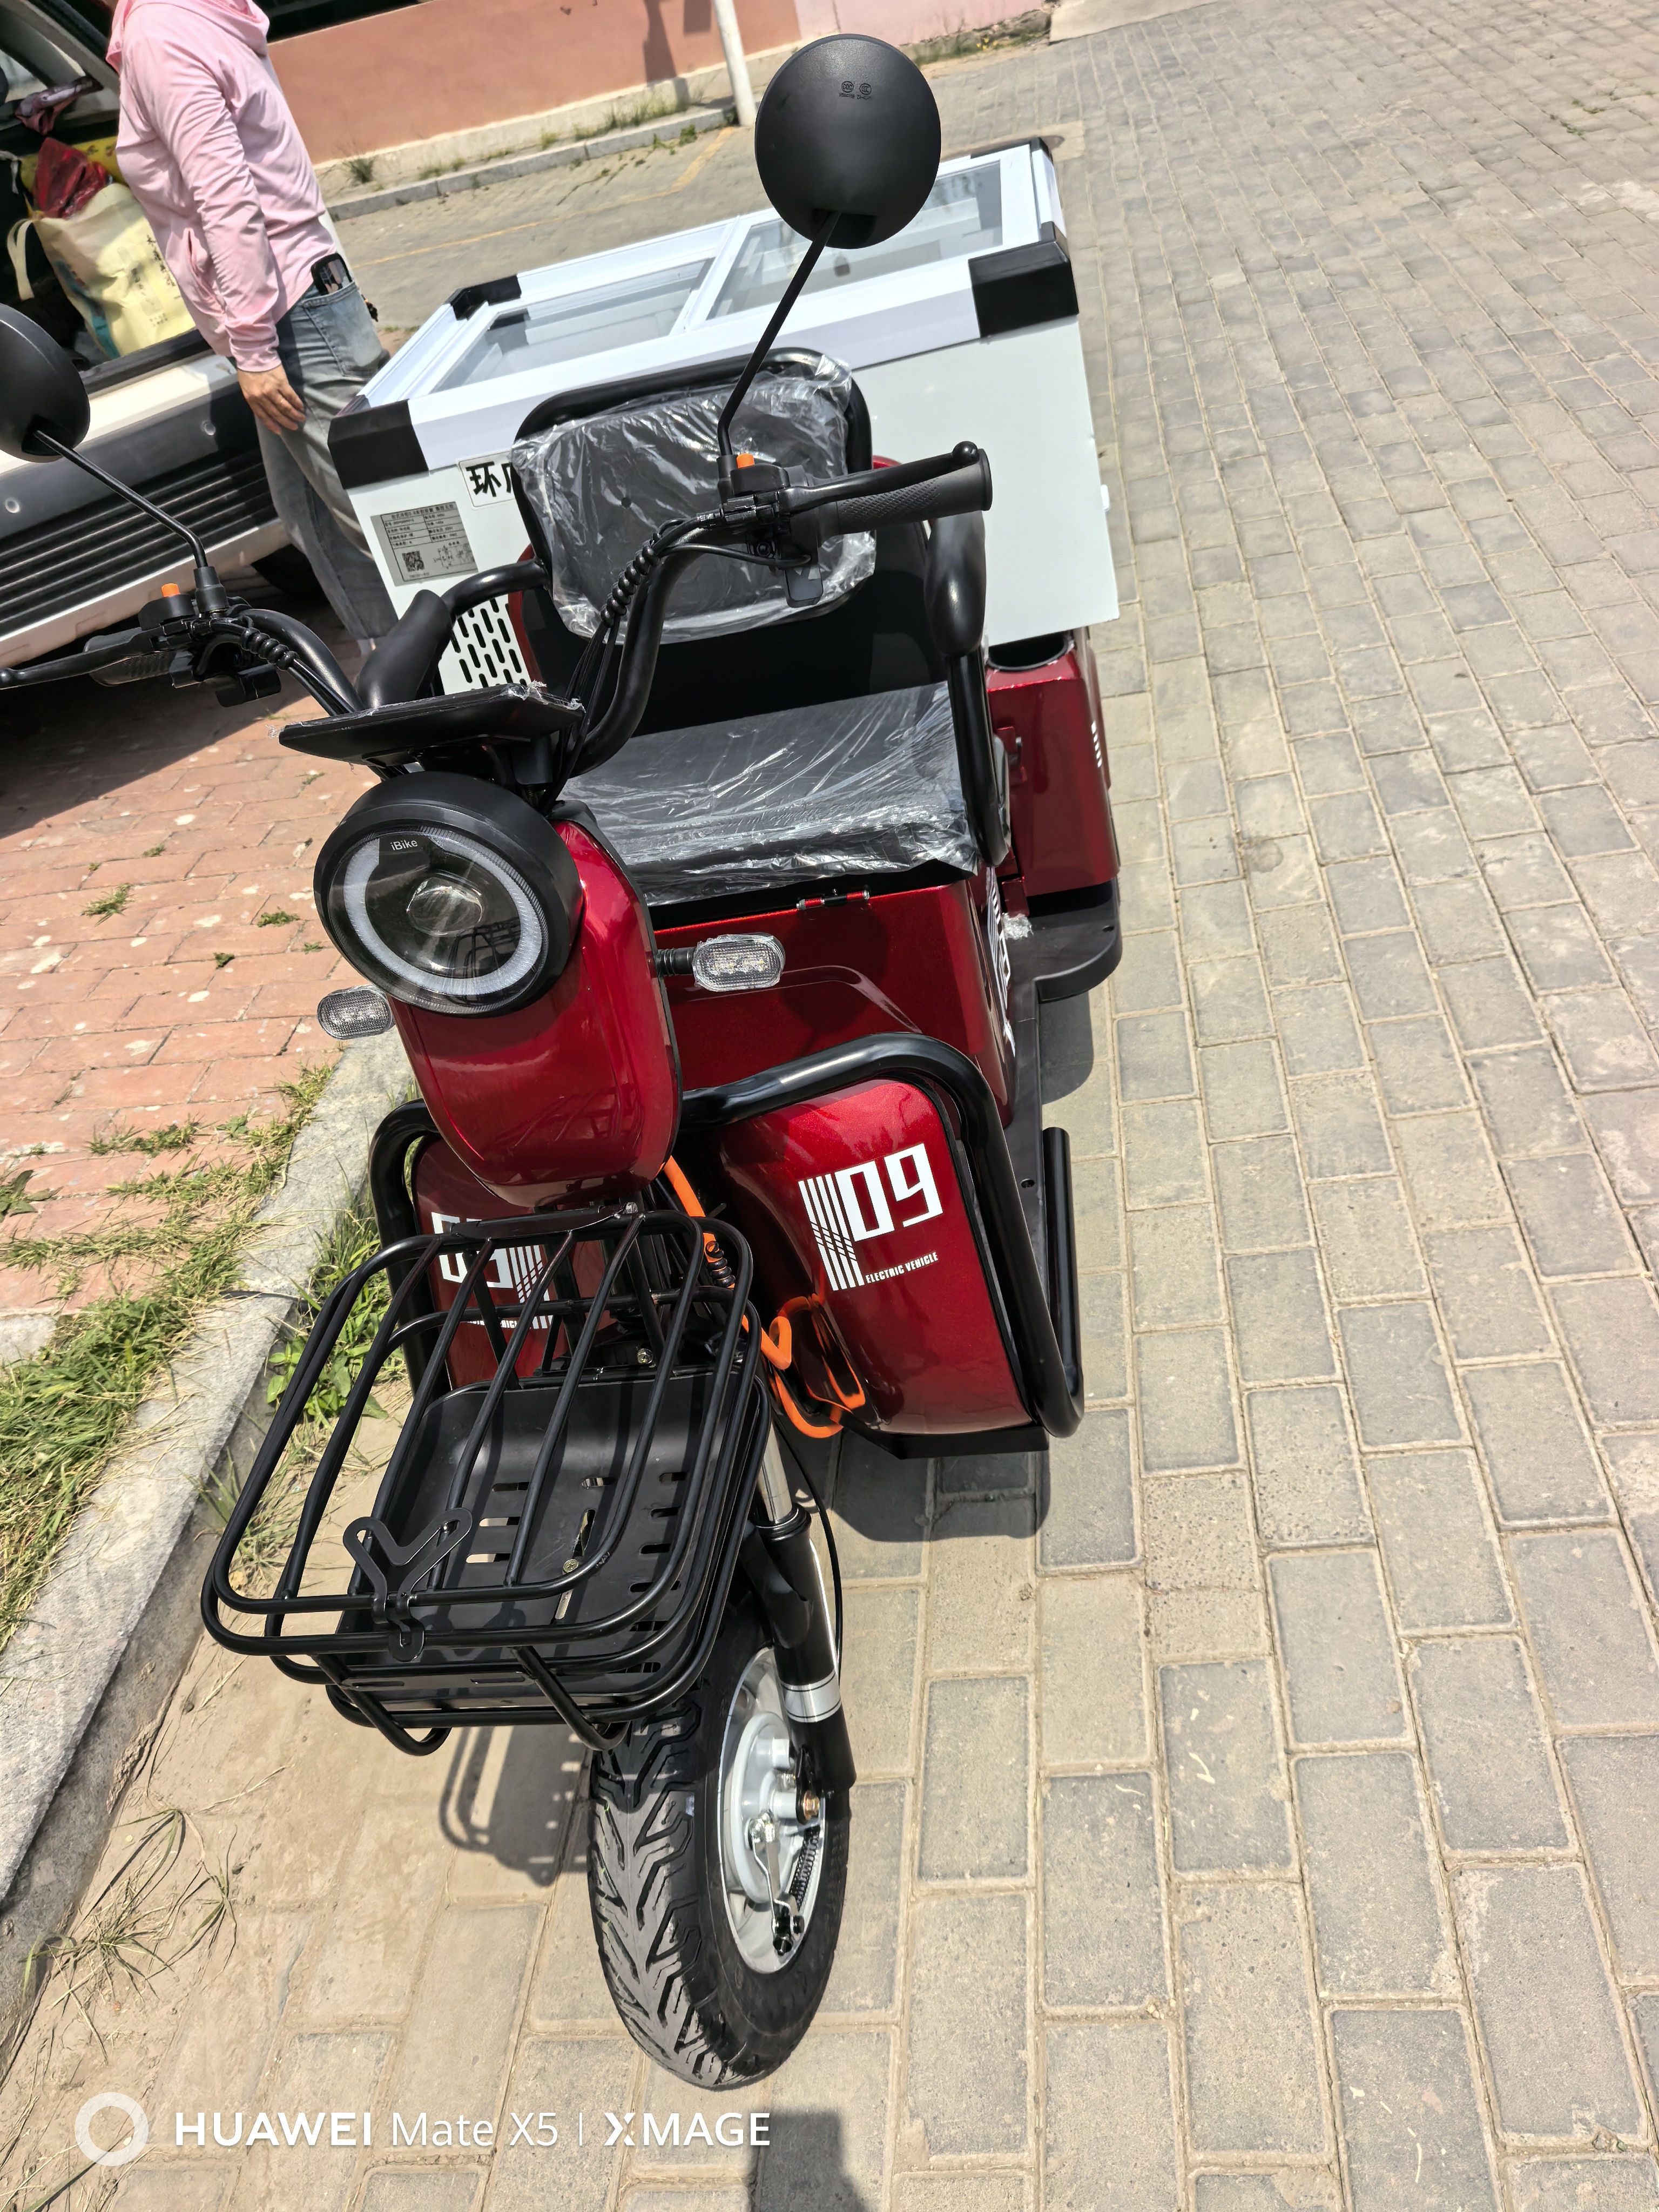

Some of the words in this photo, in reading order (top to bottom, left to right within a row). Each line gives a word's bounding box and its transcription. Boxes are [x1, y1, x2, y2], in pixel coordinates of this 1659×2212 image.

[390, 839, 418, 851] iBike
[834, 1143, 943, 1242] 09
[865, 1267, 905, 1284] ELECTRIC
[905, 1252, 938, 1272] VEHICLE
